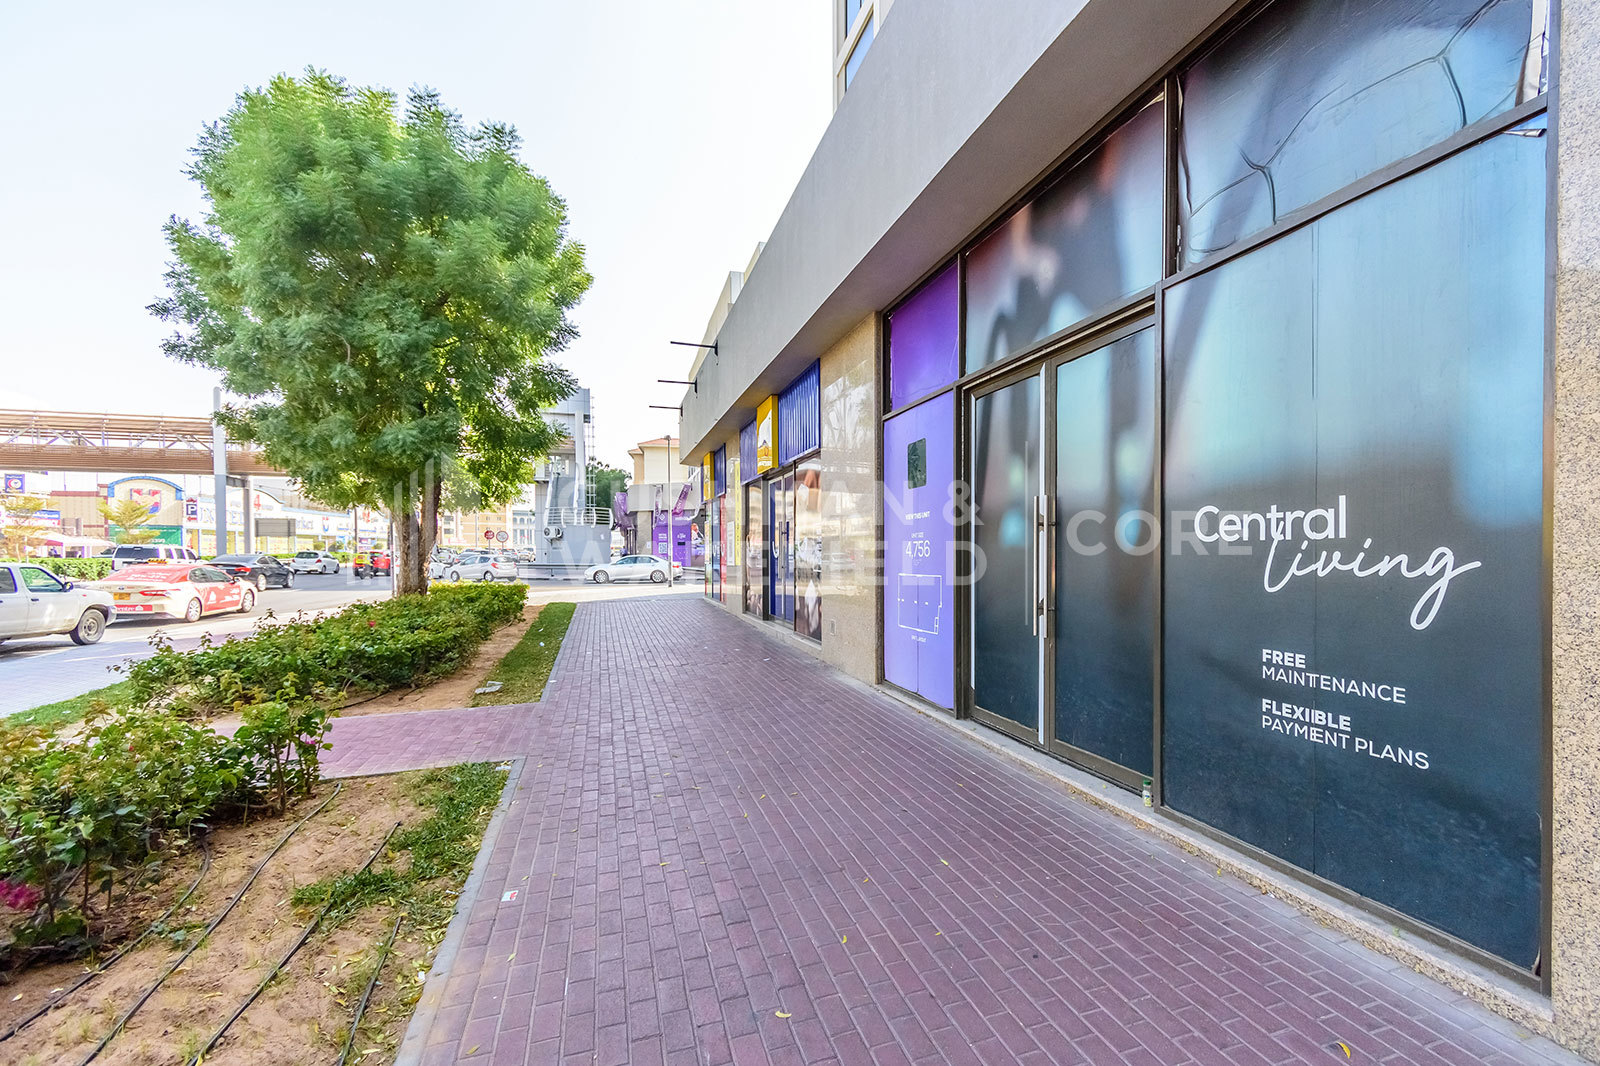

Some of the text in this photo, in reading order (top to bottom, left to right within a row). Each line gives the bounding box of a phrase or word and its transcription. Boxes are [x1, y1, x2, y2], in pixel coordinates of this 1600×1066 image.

[188, 504, 197, 515] P
[1194, 495, 1347, 543] Central
[905, 540, 931, 559] 4,756
[1264, 520, 1482, 631] living
[1262, 648, 1306, 669] FREE
[1262, 665, 1406, 704] MAINTENANCE
[1262, 714, 1430, 770] PAYMENT PLANS
